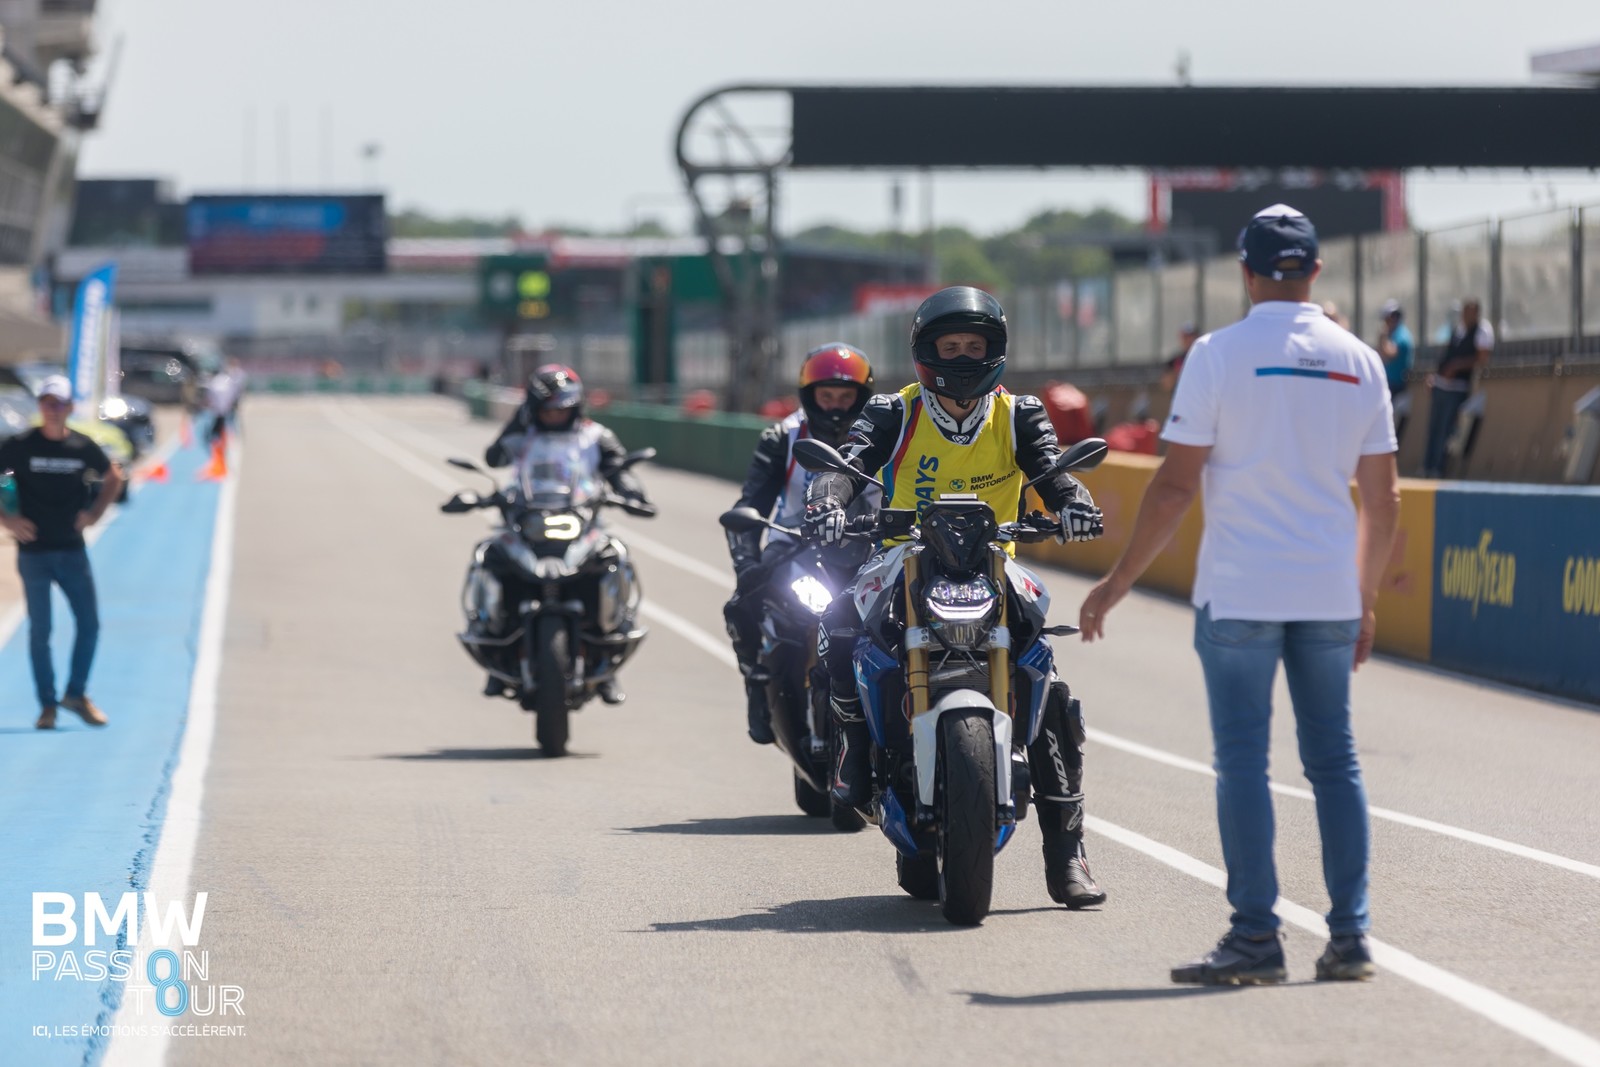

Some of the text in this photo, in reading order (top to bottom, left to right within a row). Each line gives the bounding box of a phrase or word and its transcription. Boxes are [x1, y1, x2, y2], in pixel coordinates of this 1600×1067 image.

[1298, 357, 1327, 368] STAFF
[970, 473, 994, 484] BMW
[970, 470, 1016, 491] MOTORRAD
[1442, 528, 1516, 620] GOODYEAR
[1045, 728, 1071, 796] IXON
